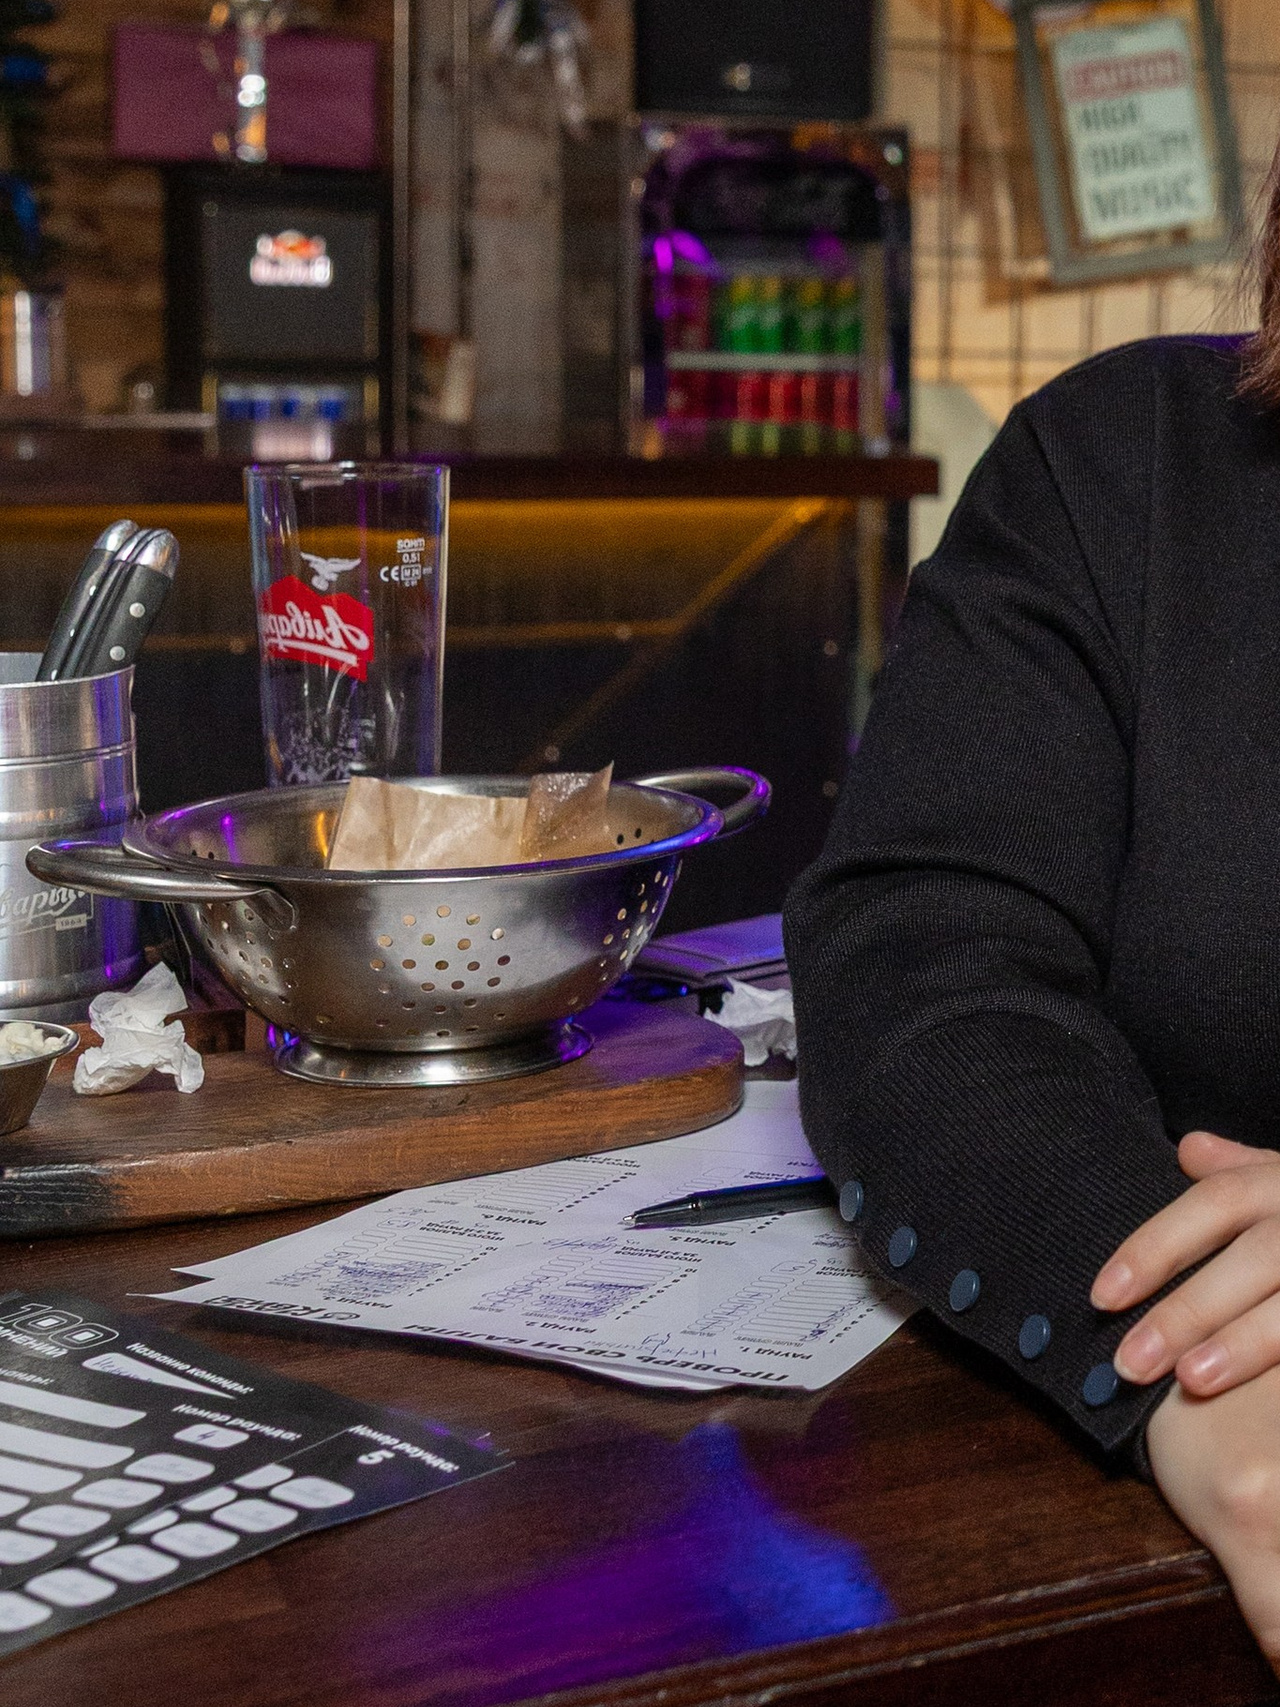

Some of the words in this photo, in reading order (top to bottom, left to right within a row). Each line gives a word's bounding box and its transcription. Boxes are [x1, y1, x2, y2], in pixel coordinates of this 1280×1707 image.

[495, 1215, 547, 1226] РАУНД
[420, 1226, 466, 1236] БАЛЛОВ
[466, 1233, 505, 1241] ИТОГО
[685, 1237, 736, 1247] РАУНД
[614, 1250, 662, 1259] БАЛЛОВ
[664, 1255, 702, 1263] ИТОГО
[337, 1298, 393, 1308] РАУНД
[0, 1303, 119, 1350] 100
[540, 1323, 597, 1334] РАУНД
[402, 1324, 528, 1345] БАЛЛЫ
[530, 1341, 626, 1359] СВОИ
[755, 1347, 813, 1360] РАУНД
[126, 1342, 191, 1371] Название
[186, 1367, 255, 1395] команды:
[636, 1355, 789, 1382] ПРОВЕРЬ
[172, 1403, 232, 1422] Номер
[225, 1417, 302, 1441] раунда:
[348, 1424, 401, 1446] Номер
[391, 1442, 460, 1473] раунда:
[357, 1449, 396, 1465] 5
